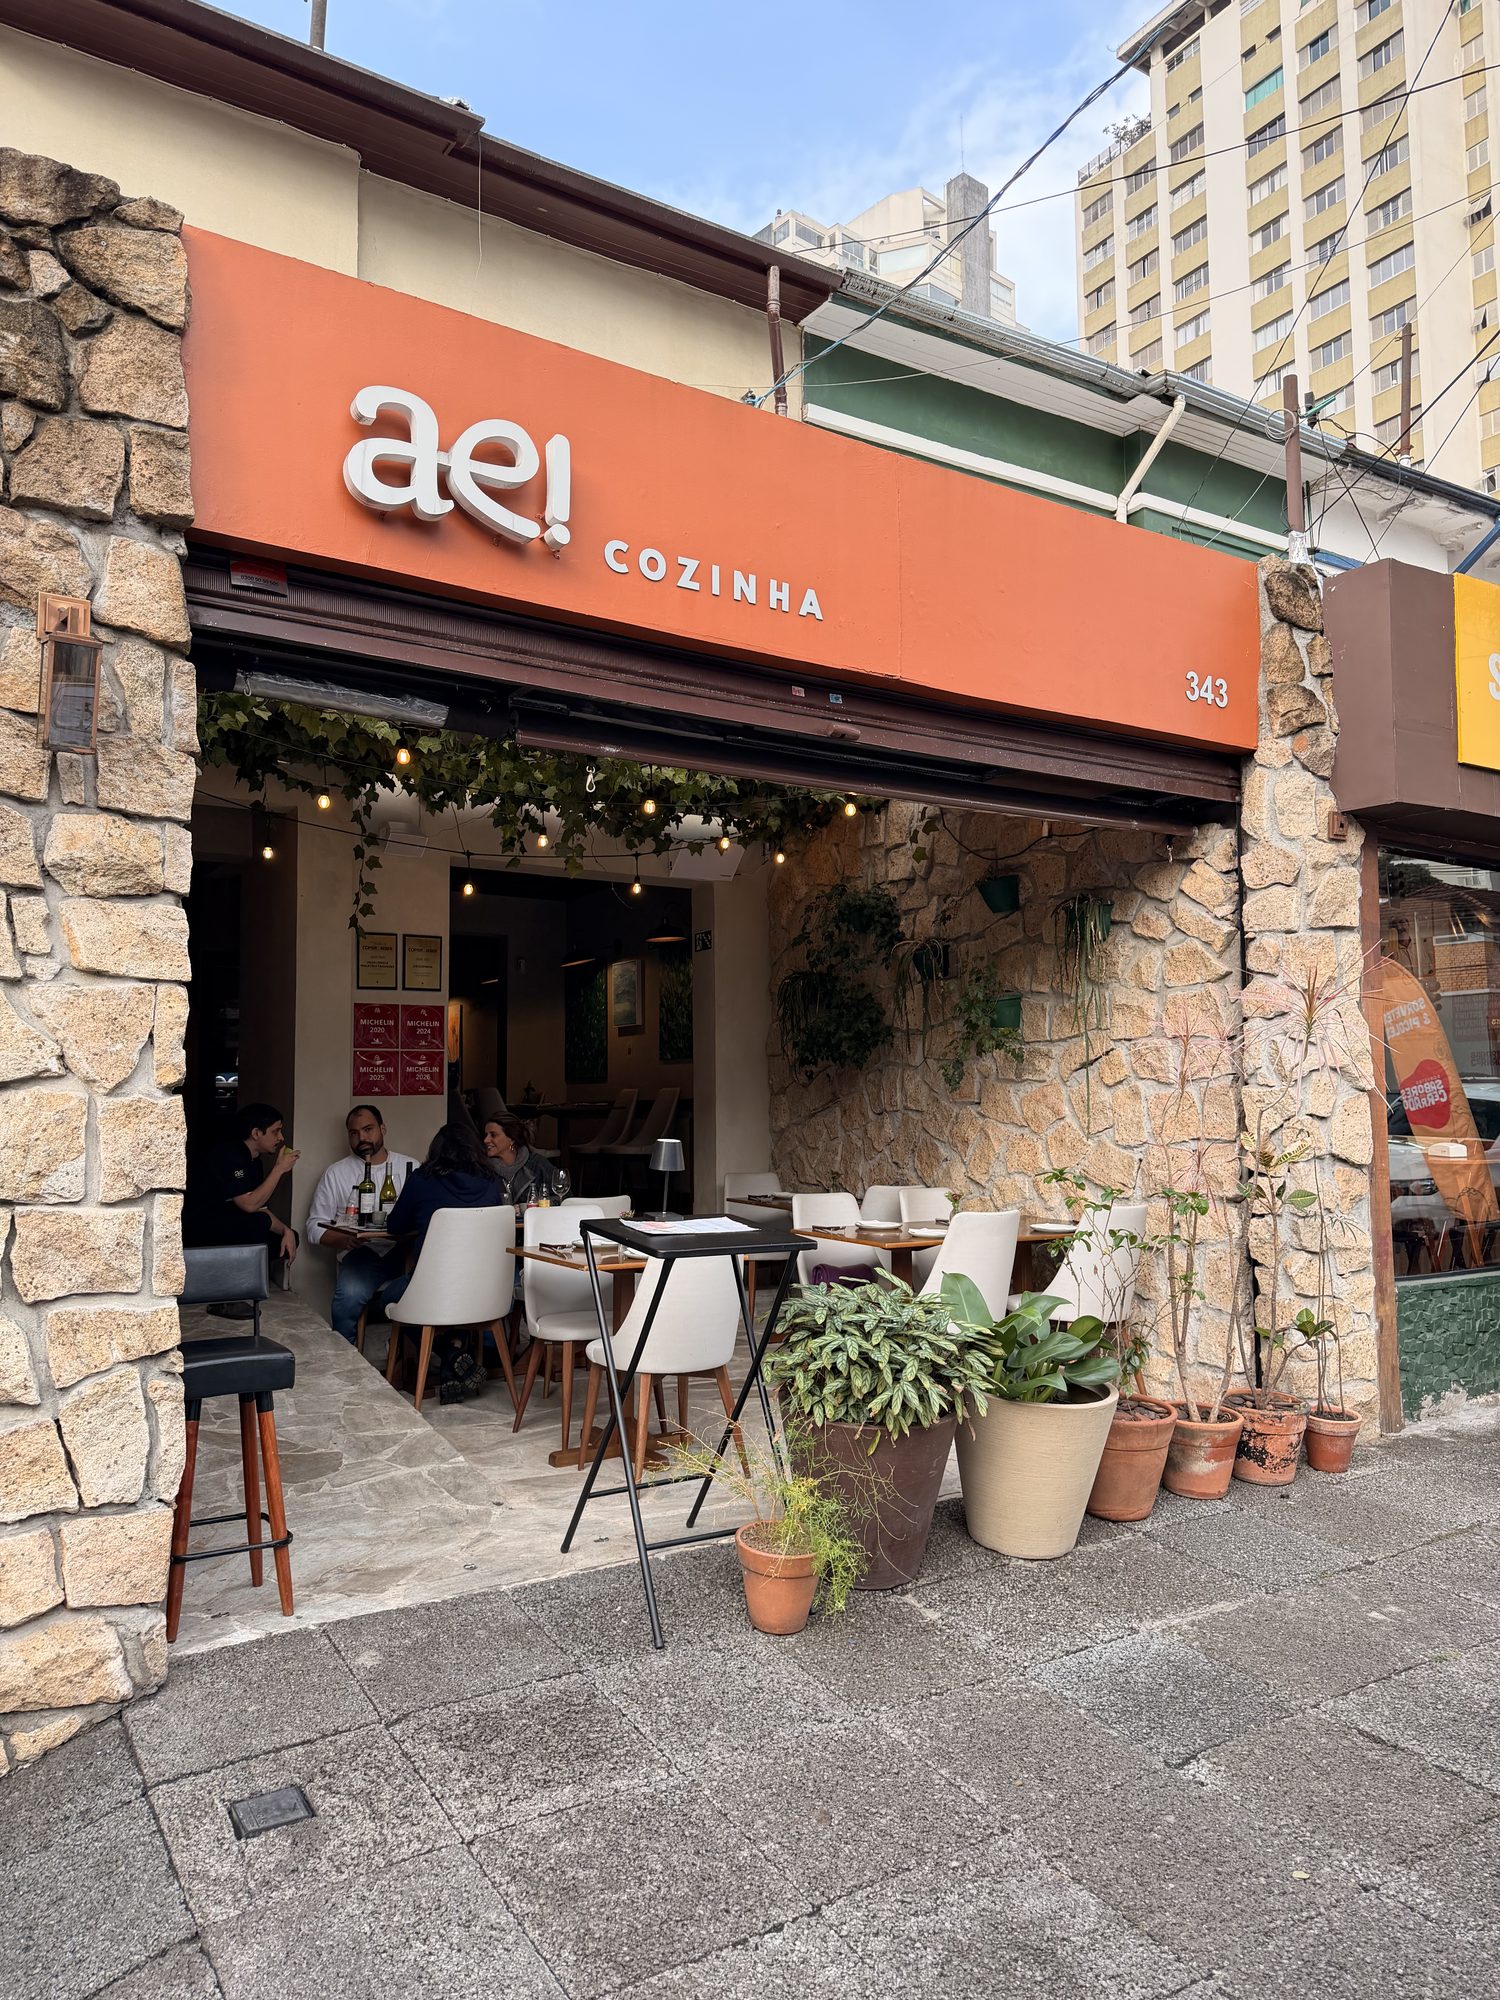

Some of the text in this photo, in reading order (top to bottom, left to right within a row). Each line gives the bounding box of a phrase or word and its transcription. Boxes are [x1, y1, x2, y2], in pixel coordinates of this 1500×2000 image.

[342, 385, 571, 551] ae!
[603, 539, 825, 621] COZINHA
[1185, 671, 1229, 708] 343
[360, 1018, 394, 1026] MICHELIN
